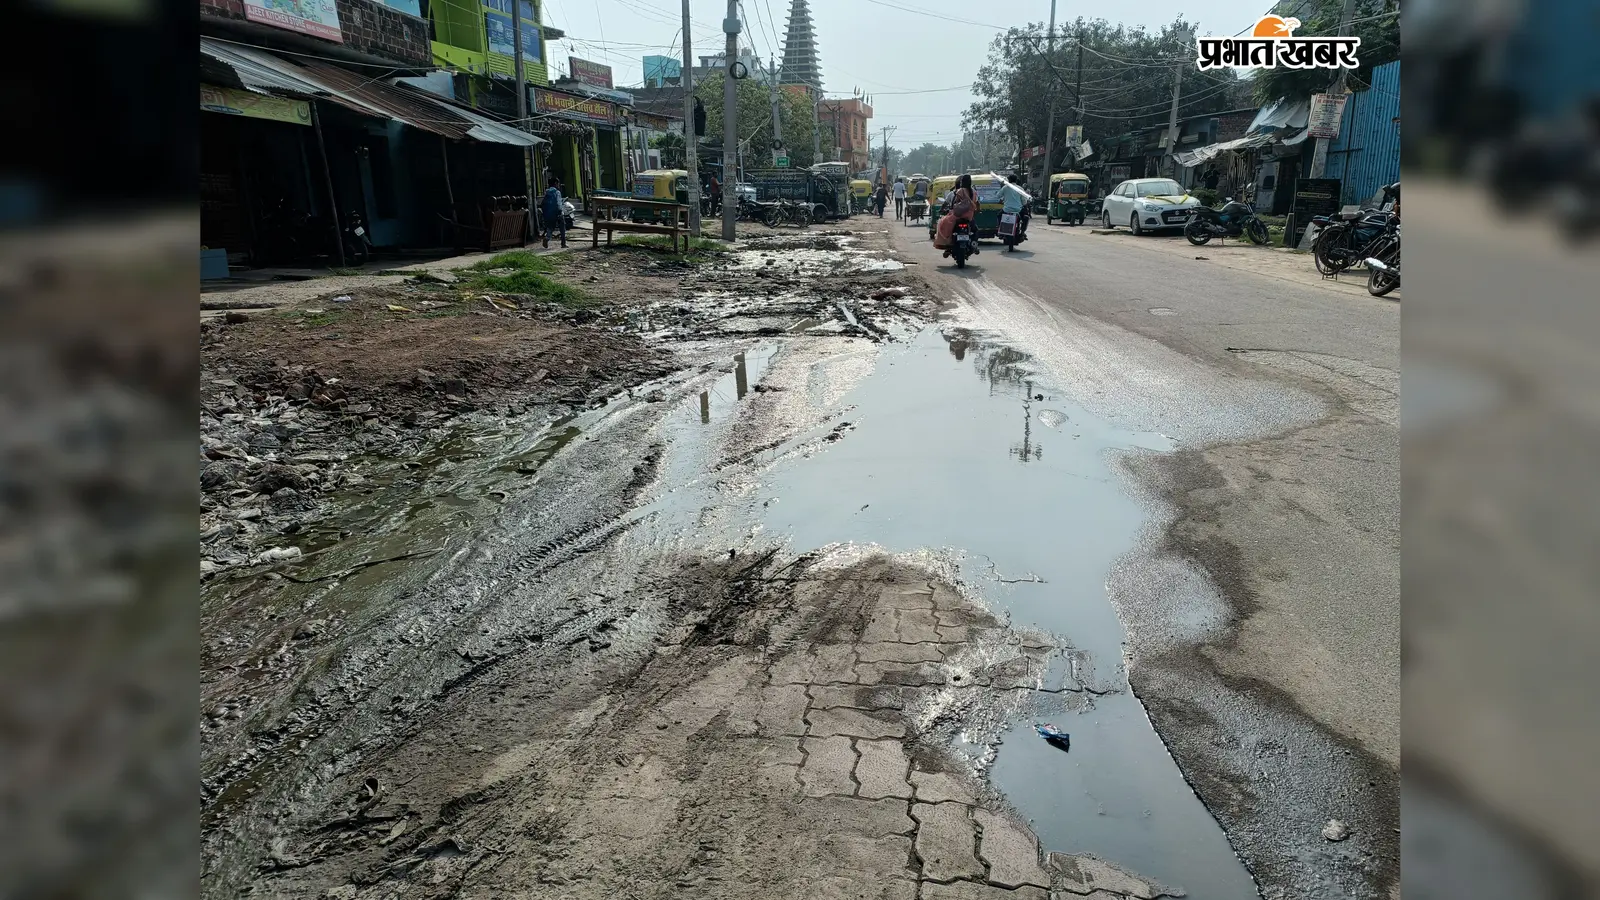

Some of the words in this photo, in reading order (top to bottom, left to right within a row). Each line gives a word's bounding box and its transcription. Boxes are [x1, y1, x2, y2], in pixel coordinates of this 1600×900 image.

[247, 5, 265, 17] AJEET
[265, 9, 289, 23] KITCHEN
[289, 16, 306, 28] STORE
[554, 97, 575, 109] भवानी
